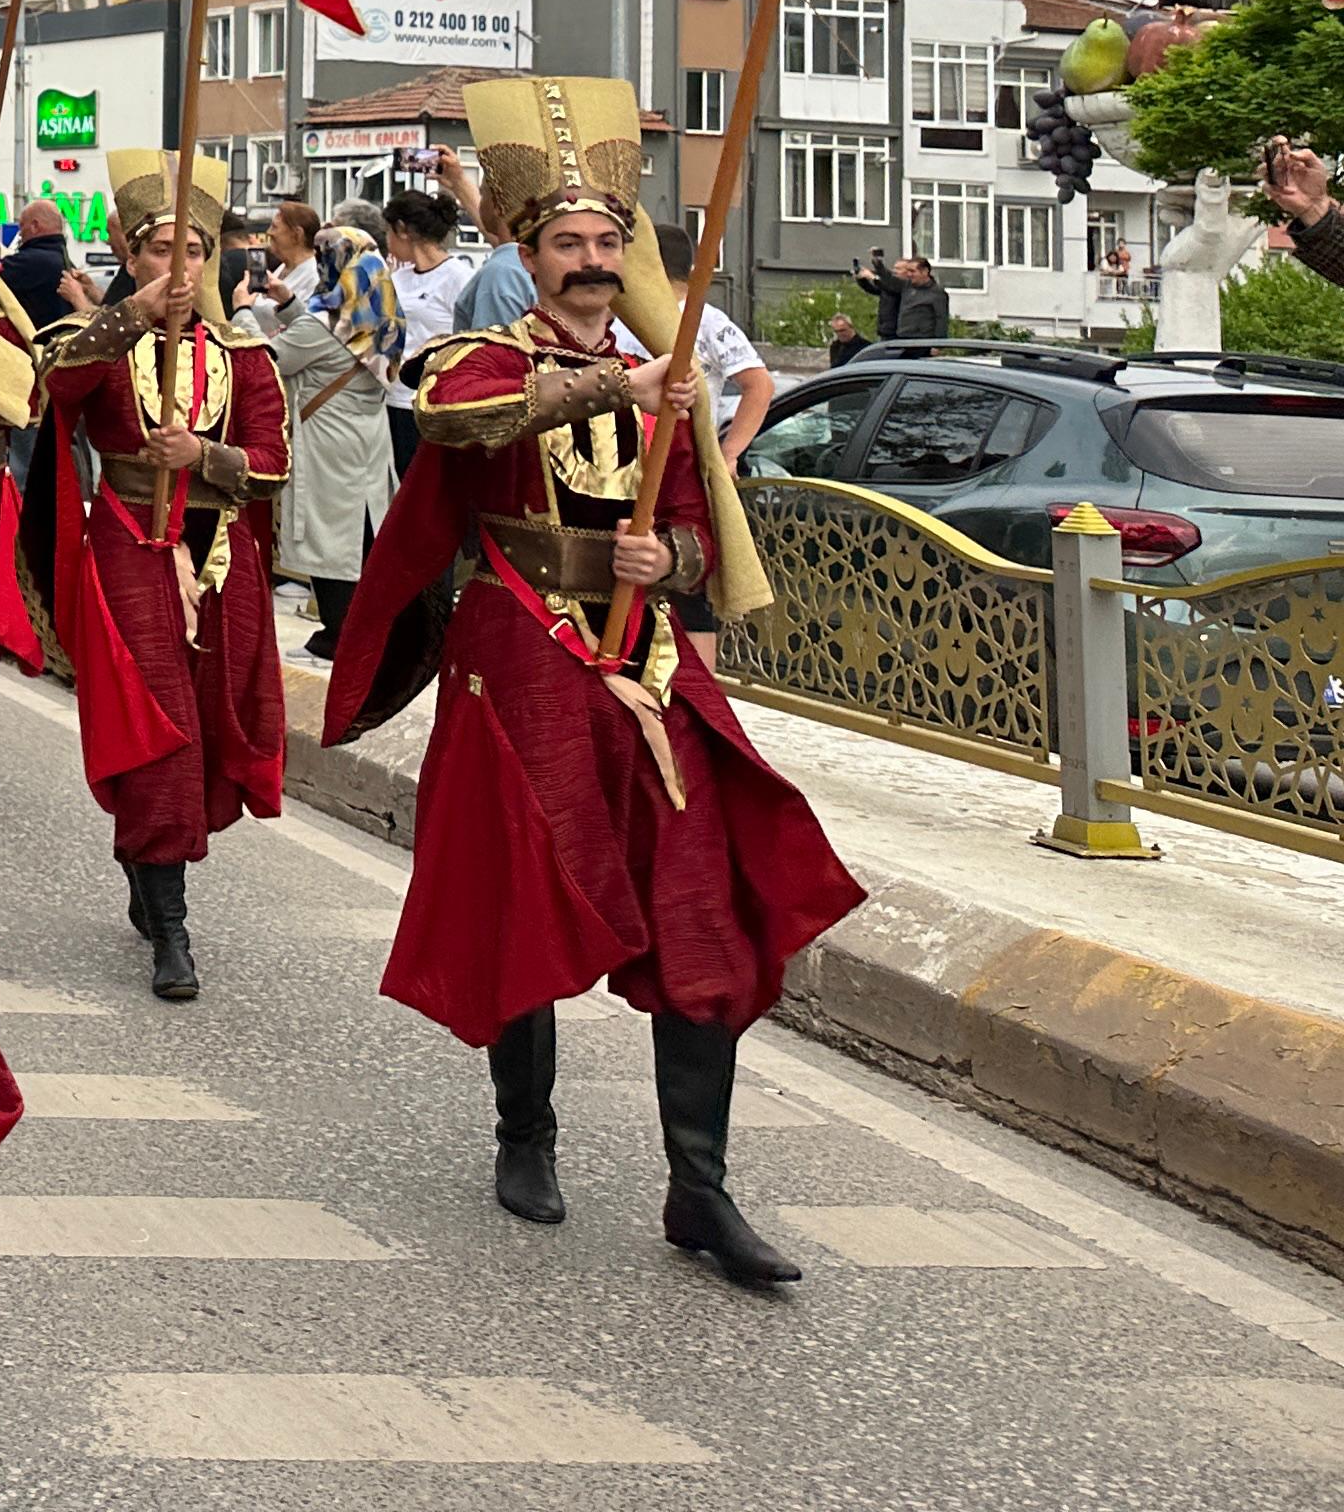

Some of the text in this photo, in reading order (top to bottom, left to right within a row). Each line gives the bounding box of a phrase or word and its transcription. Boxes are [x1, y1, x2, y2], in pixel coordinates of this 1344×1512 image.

[394, 9, 404, 27] 0
[409, 11, 434, 29] 212
[439, 13, 467, 30] 400
[472, 15, 487, 32] 18
[492, 16, 510, 33] 00
[394, 32, 497, 48] www.yuceler.com
[38, 115, 95, 139] AŞINAM
